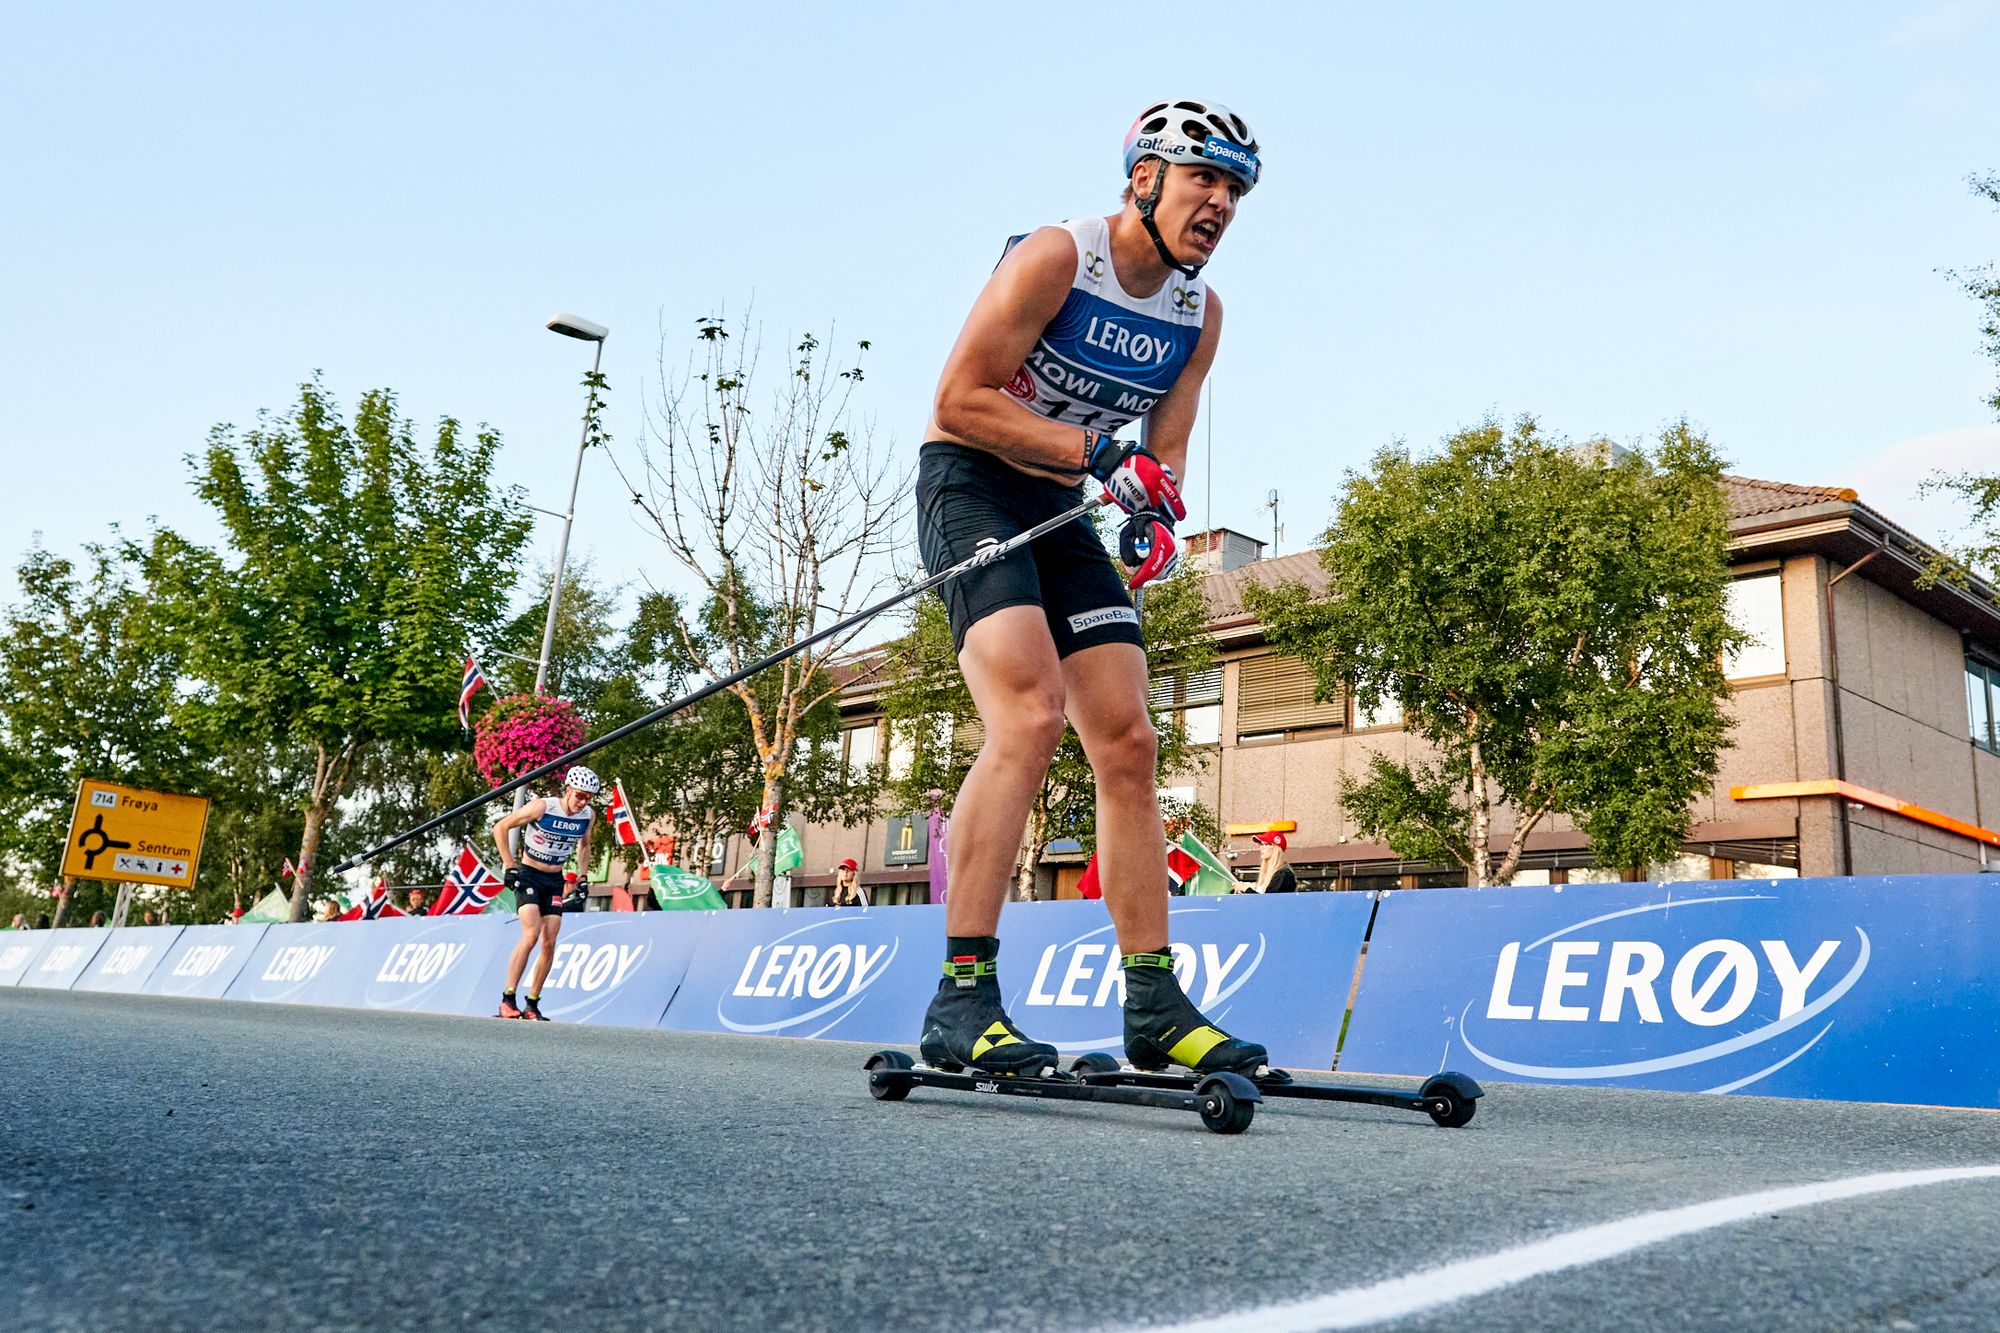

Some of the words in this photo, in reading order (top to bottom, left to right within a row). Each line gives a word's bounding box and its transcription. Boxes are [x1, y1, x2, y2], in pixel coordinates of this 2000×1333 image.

[1136, 138, 1186, 156] catlike
[1085, 316, 1171, 364] LERØY
[94, 793, 113, 805] 714
[121, 796, 158, 812] Frøya
[552, 820, 580, 830] LERØY
[137, 841, 191, 857] Sentrum
[172, 944, 235, 977] LERØY
[261, 944, 336, 982] LERØY
[375, 942, 467, 984] LERØY
[732, 943, 889, 999] LERØY
[1486, 939, 1842, 1027] LERØY
